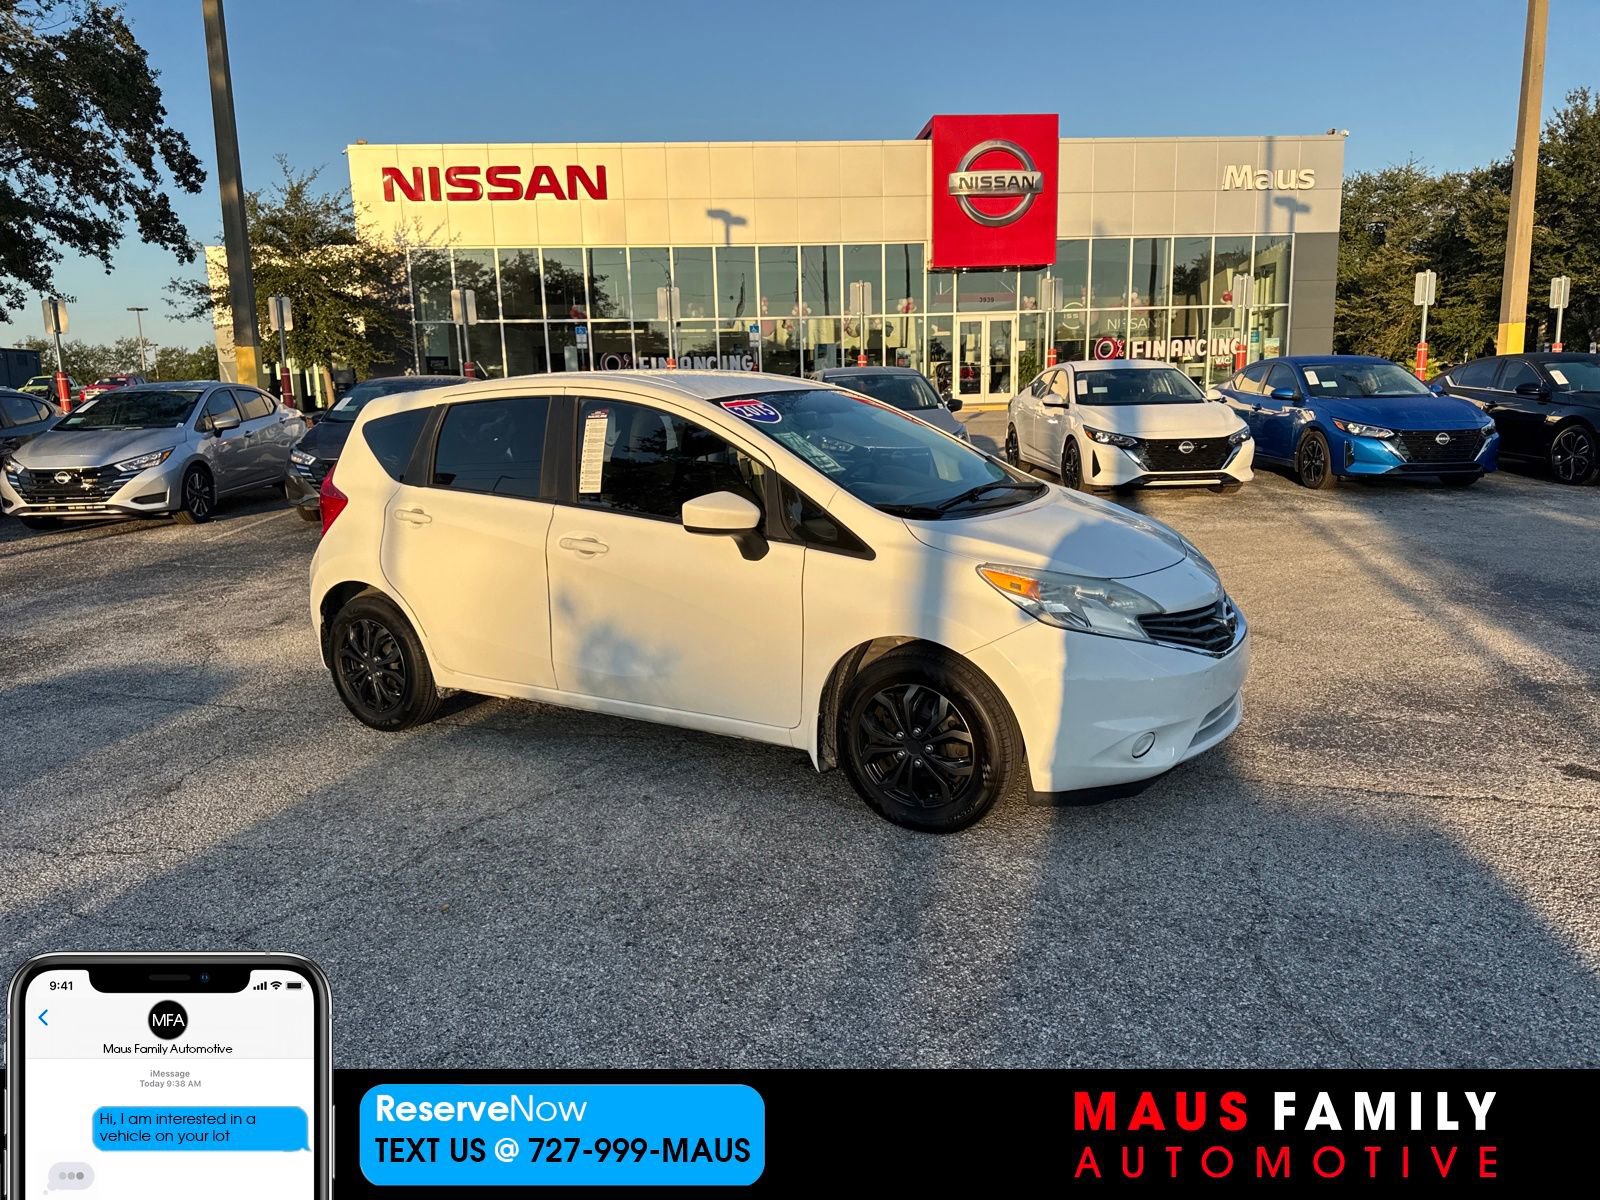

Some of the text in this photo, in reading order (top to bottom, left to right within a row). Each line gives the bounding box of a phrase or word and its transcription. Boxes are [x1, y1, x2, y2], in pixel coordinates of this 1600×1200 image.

[381, 165, 607, 202] NISSAN
[958, 175, 1035, 190] NISSAN
[1223, 164, 1316, 191] Maus
[733, 404, 776, 417] 2015
